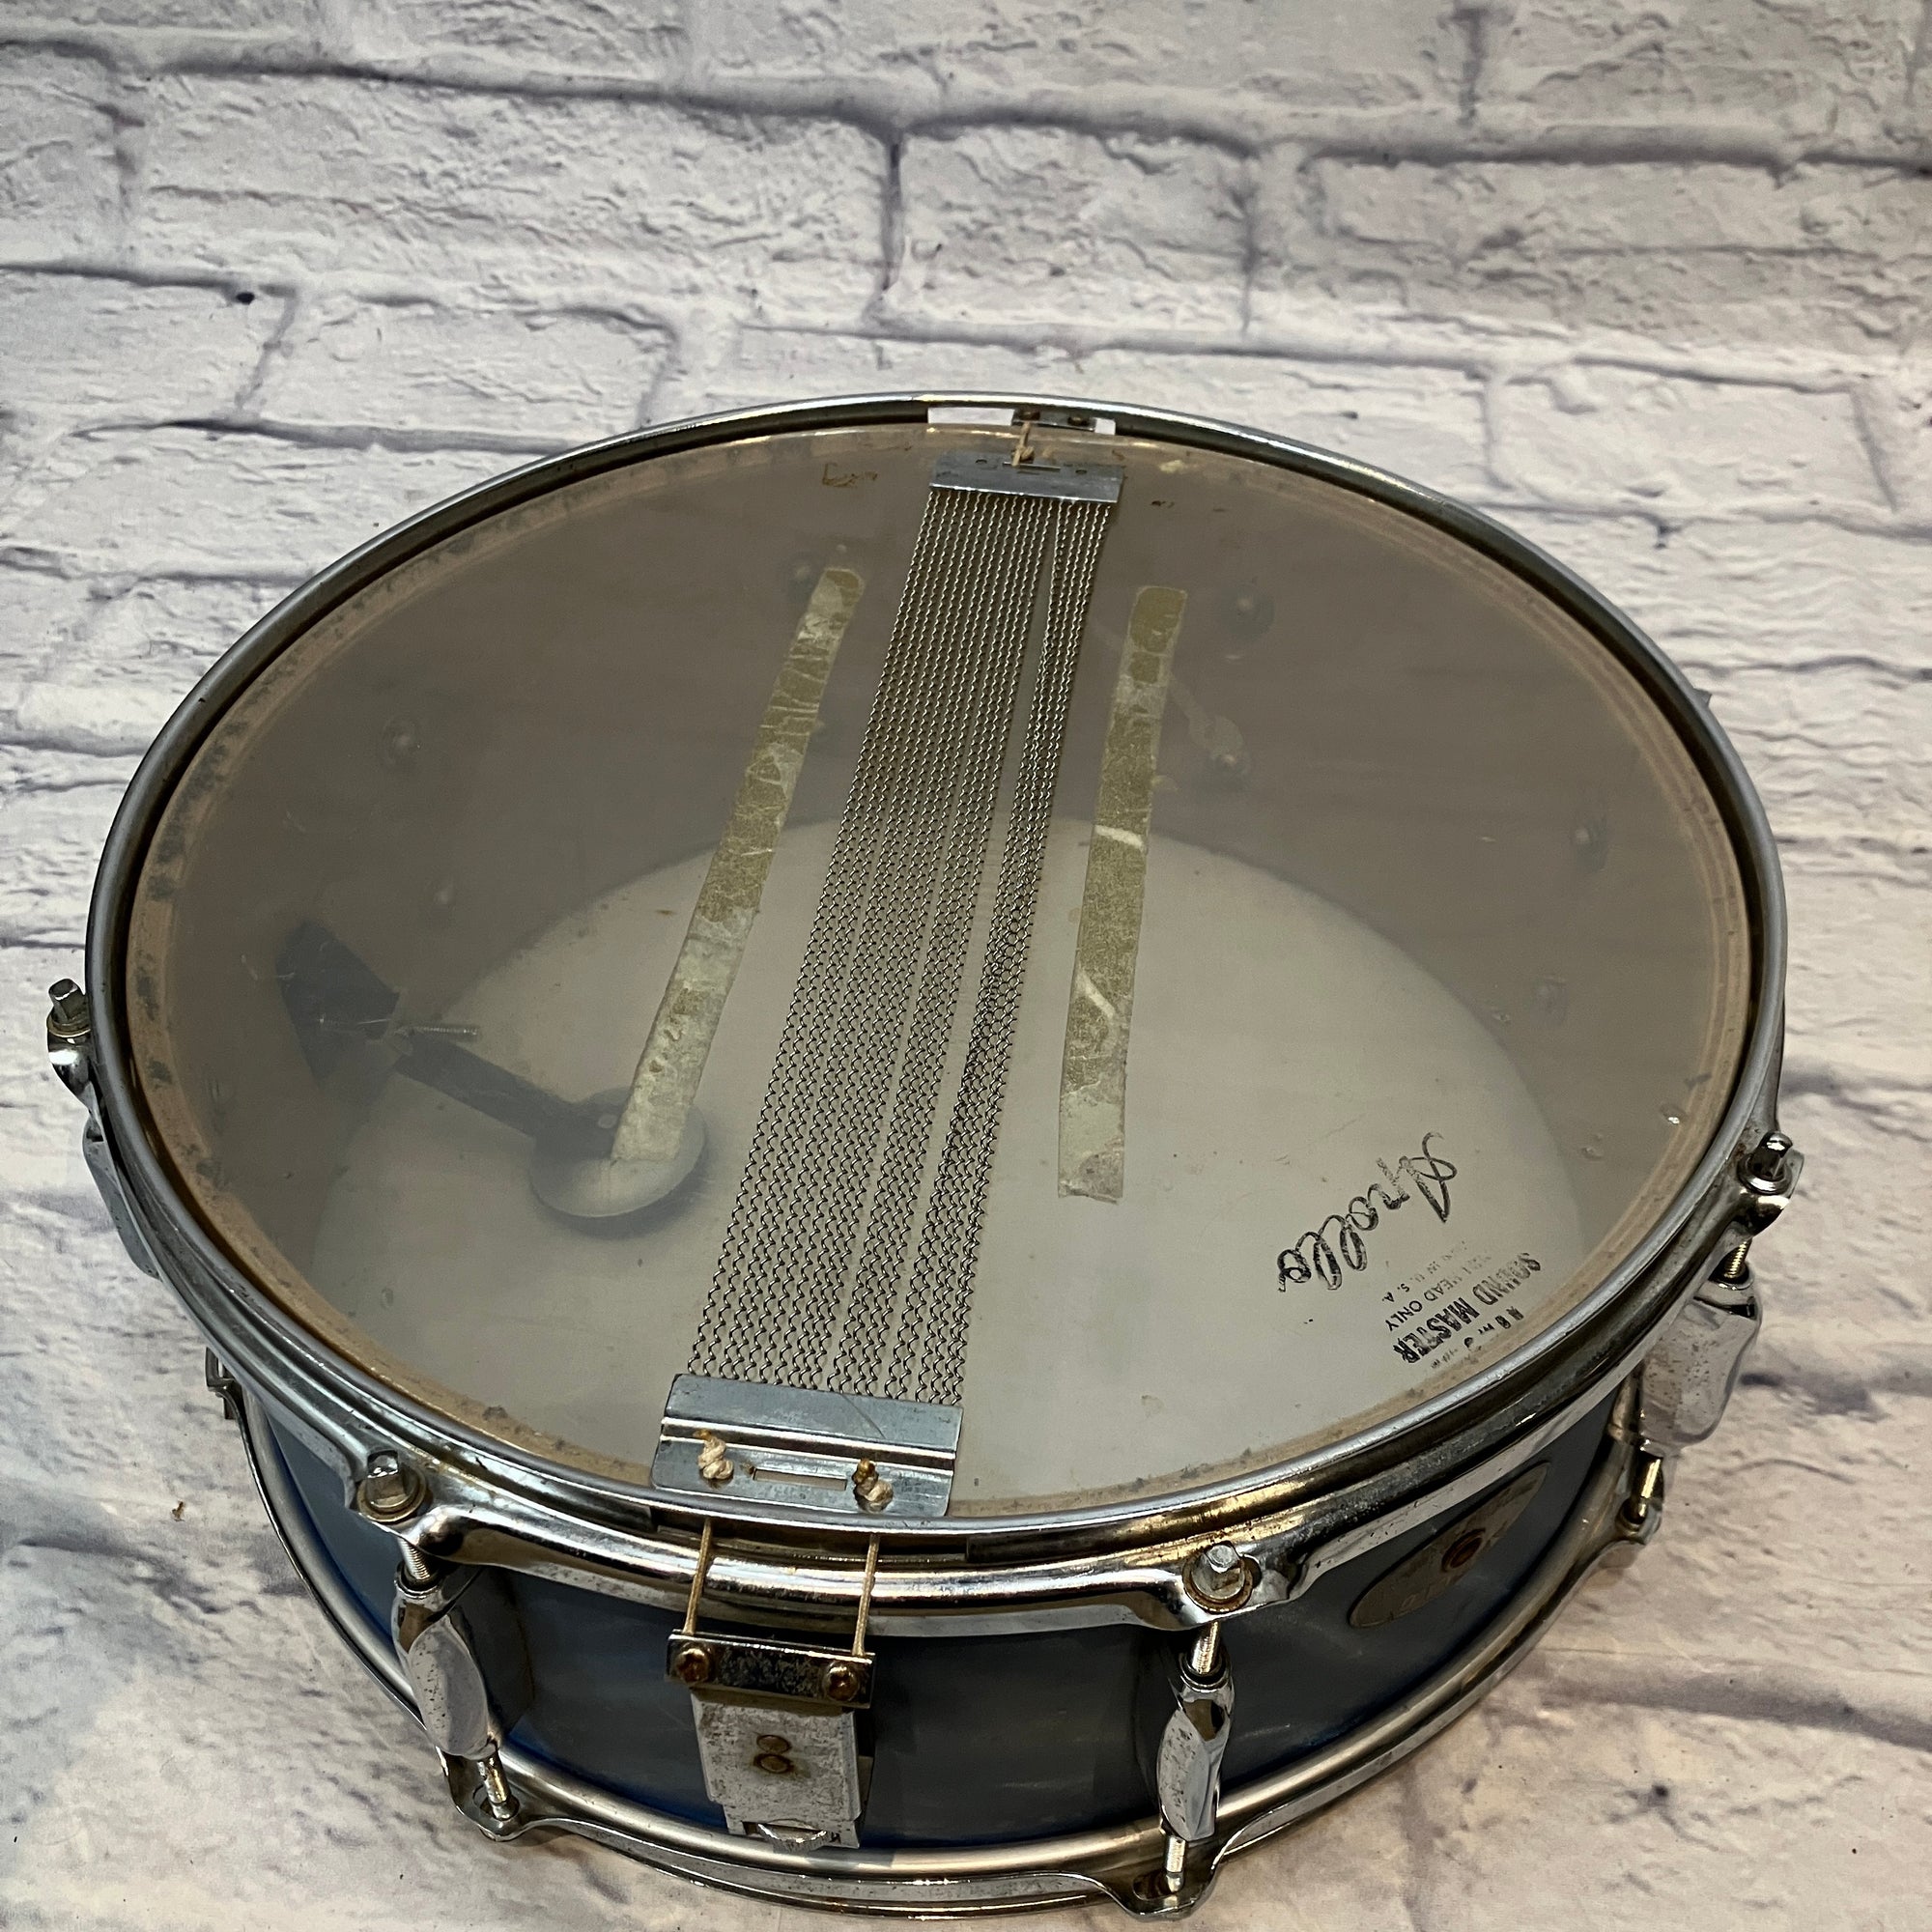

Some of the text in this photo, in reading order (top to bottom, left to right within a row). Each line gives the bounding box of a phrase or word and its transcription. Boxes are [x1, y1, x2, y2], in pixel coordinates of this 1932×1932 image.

[1276, 1131, 1457, 1293] Apollo
[1472, 1252, 1542, 1305] SOUND
[1384, 1300, 1423, 1331] ONLY
[1393, 1297, 1480, 1364] MASTER
